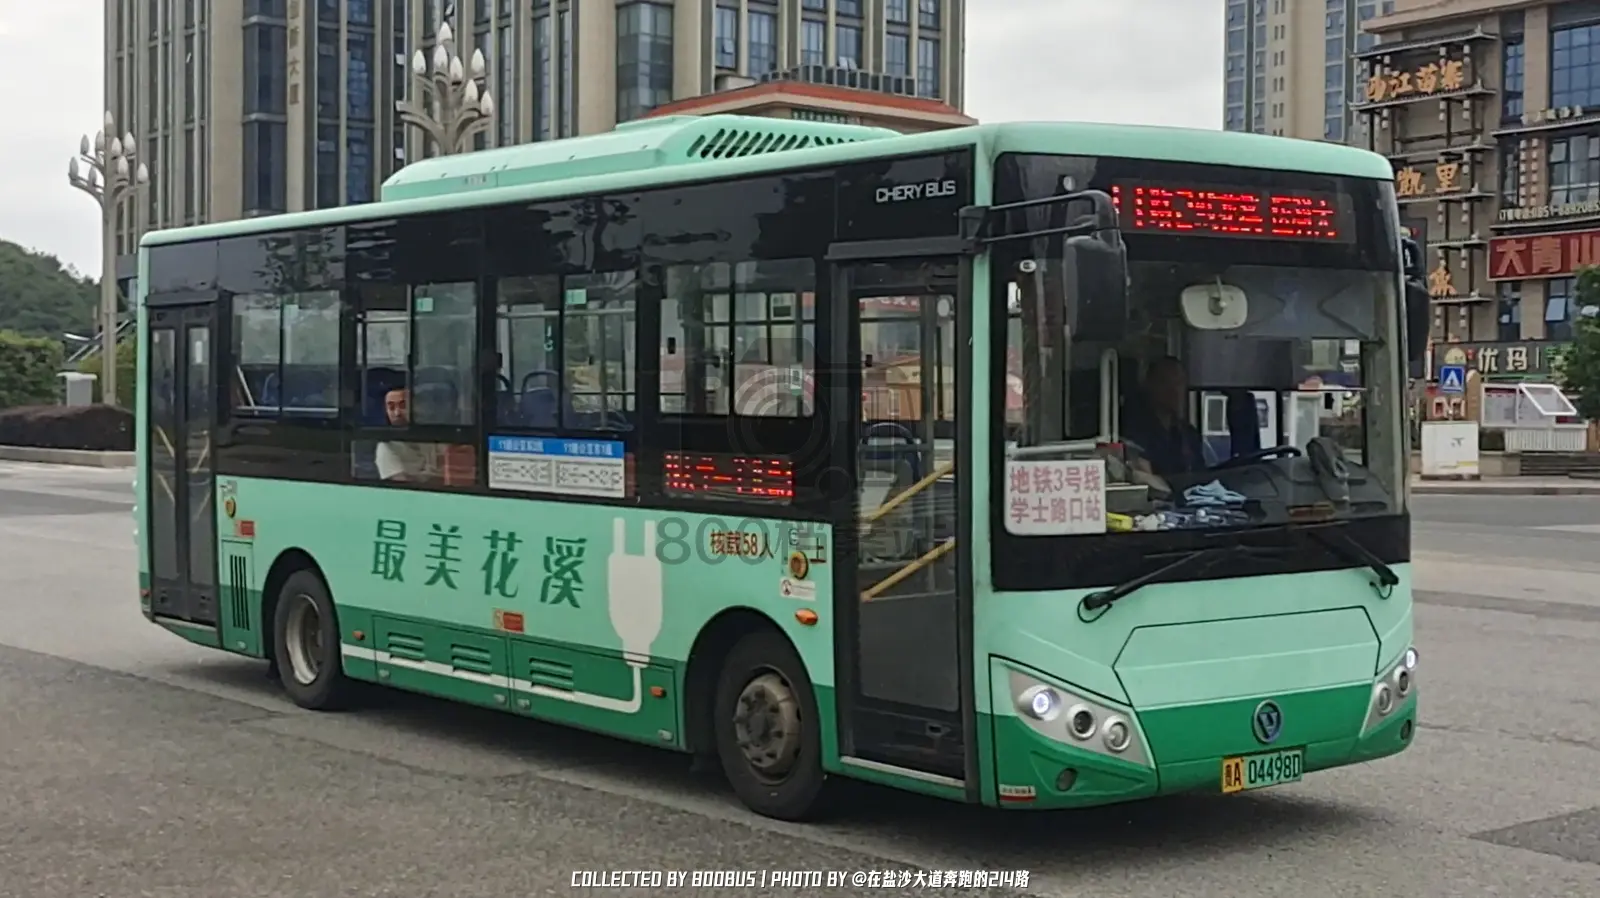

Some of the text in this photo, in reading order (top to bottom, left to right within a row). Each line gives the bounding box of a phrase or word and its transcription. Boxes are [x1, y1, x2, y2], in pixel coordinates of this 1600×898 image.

[876, 180, 956, 202] CHERY BUS
[1010, 465, 1100, 493] 地铁3号线
[1010, 495, 1100, 524] 学士路口站
[710, 529, 774, 559] 核载58人
[371, 518, 588, 609] 最美花溪
[1248, 754, 1301, 784] 04498D
